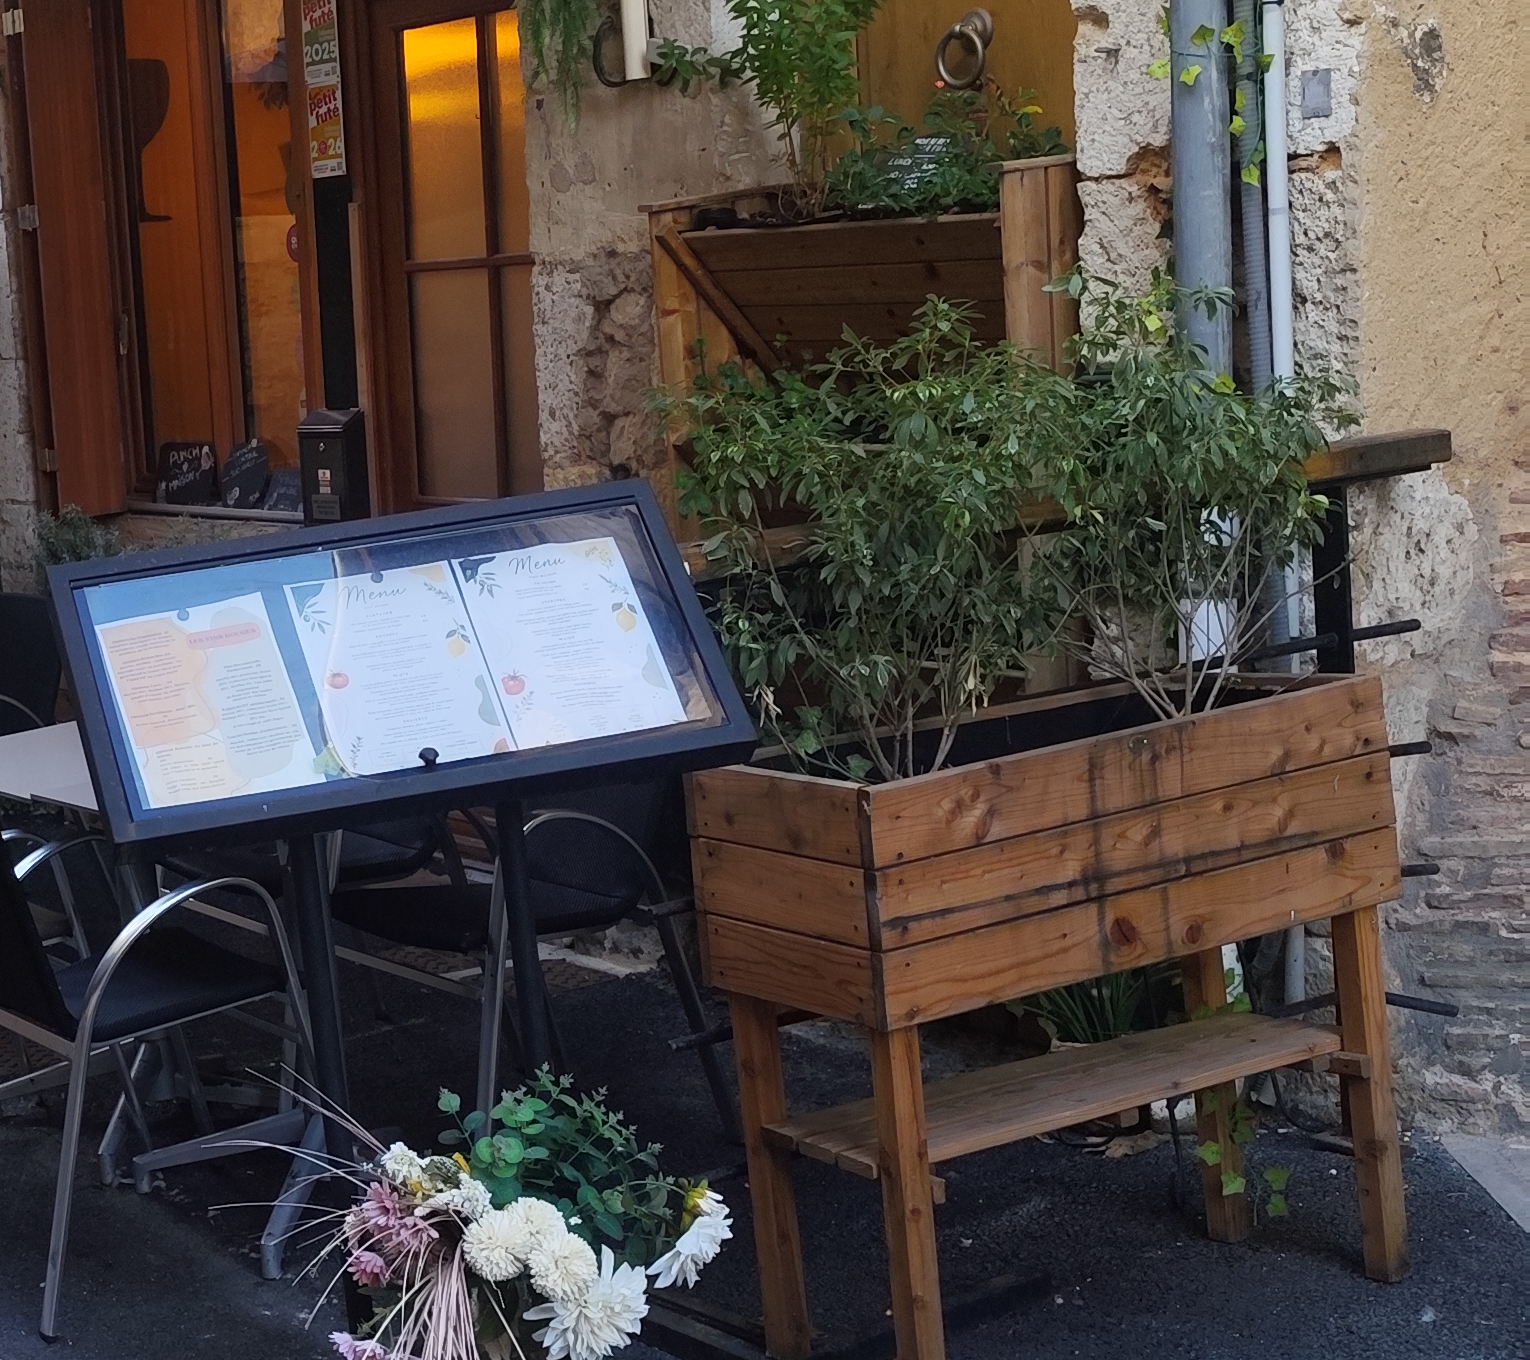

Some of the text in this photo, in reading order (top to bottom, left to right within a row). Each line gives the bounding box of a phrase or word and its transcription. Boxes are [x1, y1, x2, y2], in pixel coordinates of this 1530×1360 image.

[309, 6, 334, 30] futé
[304, 41, 337, 63] 2025
[309, 88, 338, 116] petit
[315, 103, 340, 126] futé
[170, 446, 200, 465] PUNCH
[508, 555, 566, 575] Menu
[338, 585, 407, 609] Menu
